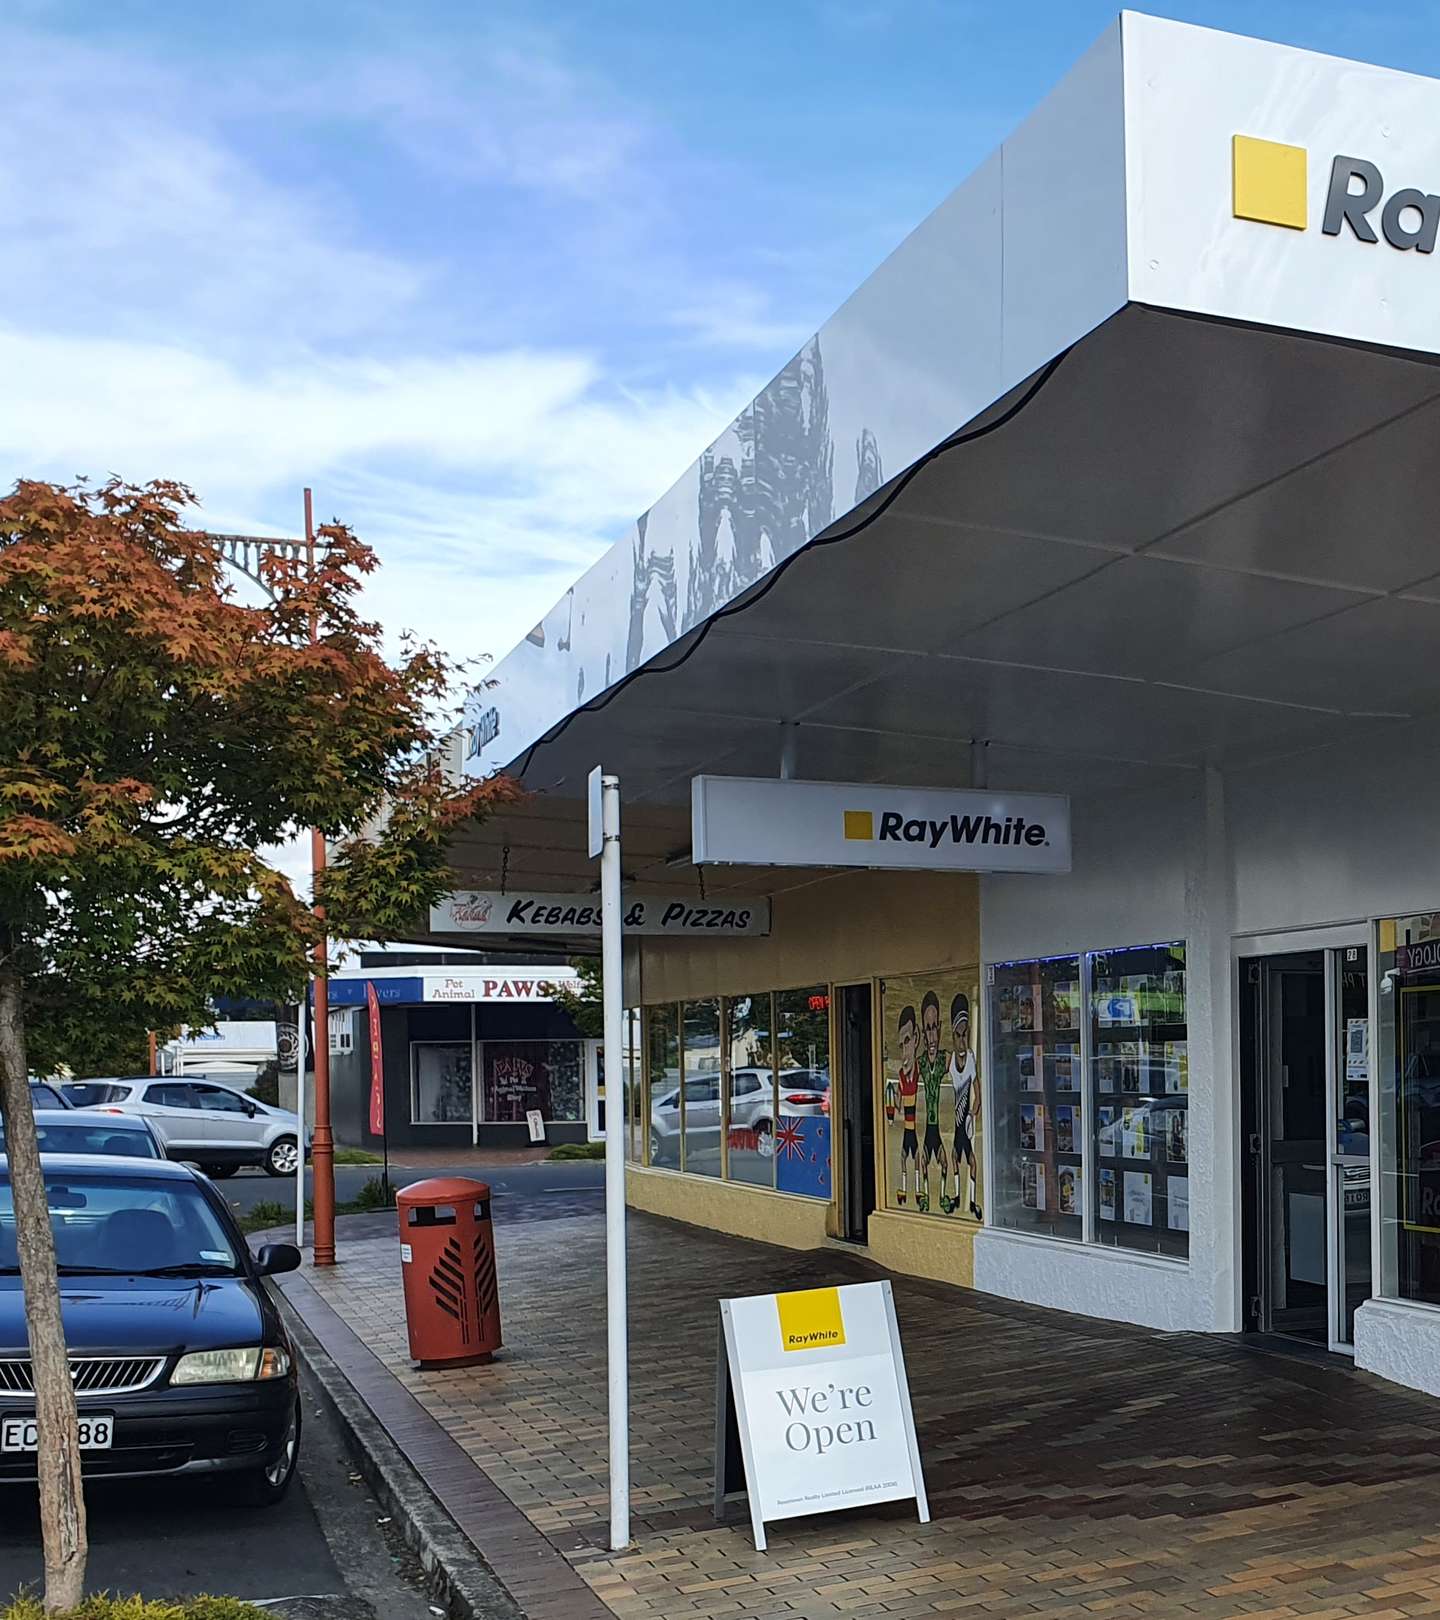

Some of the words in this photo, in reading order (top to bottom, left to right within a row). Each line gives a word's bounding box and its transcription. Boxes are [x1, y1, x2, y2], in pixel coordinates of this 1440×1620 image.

[624, 902, 646, 927] &
[660, 902, 751, 929] PIZZAS
[482, 980, 551, 998] PAWS
[5, 1423, 108, 1446] EC88
[785, 1418, 878, 1455] Open
